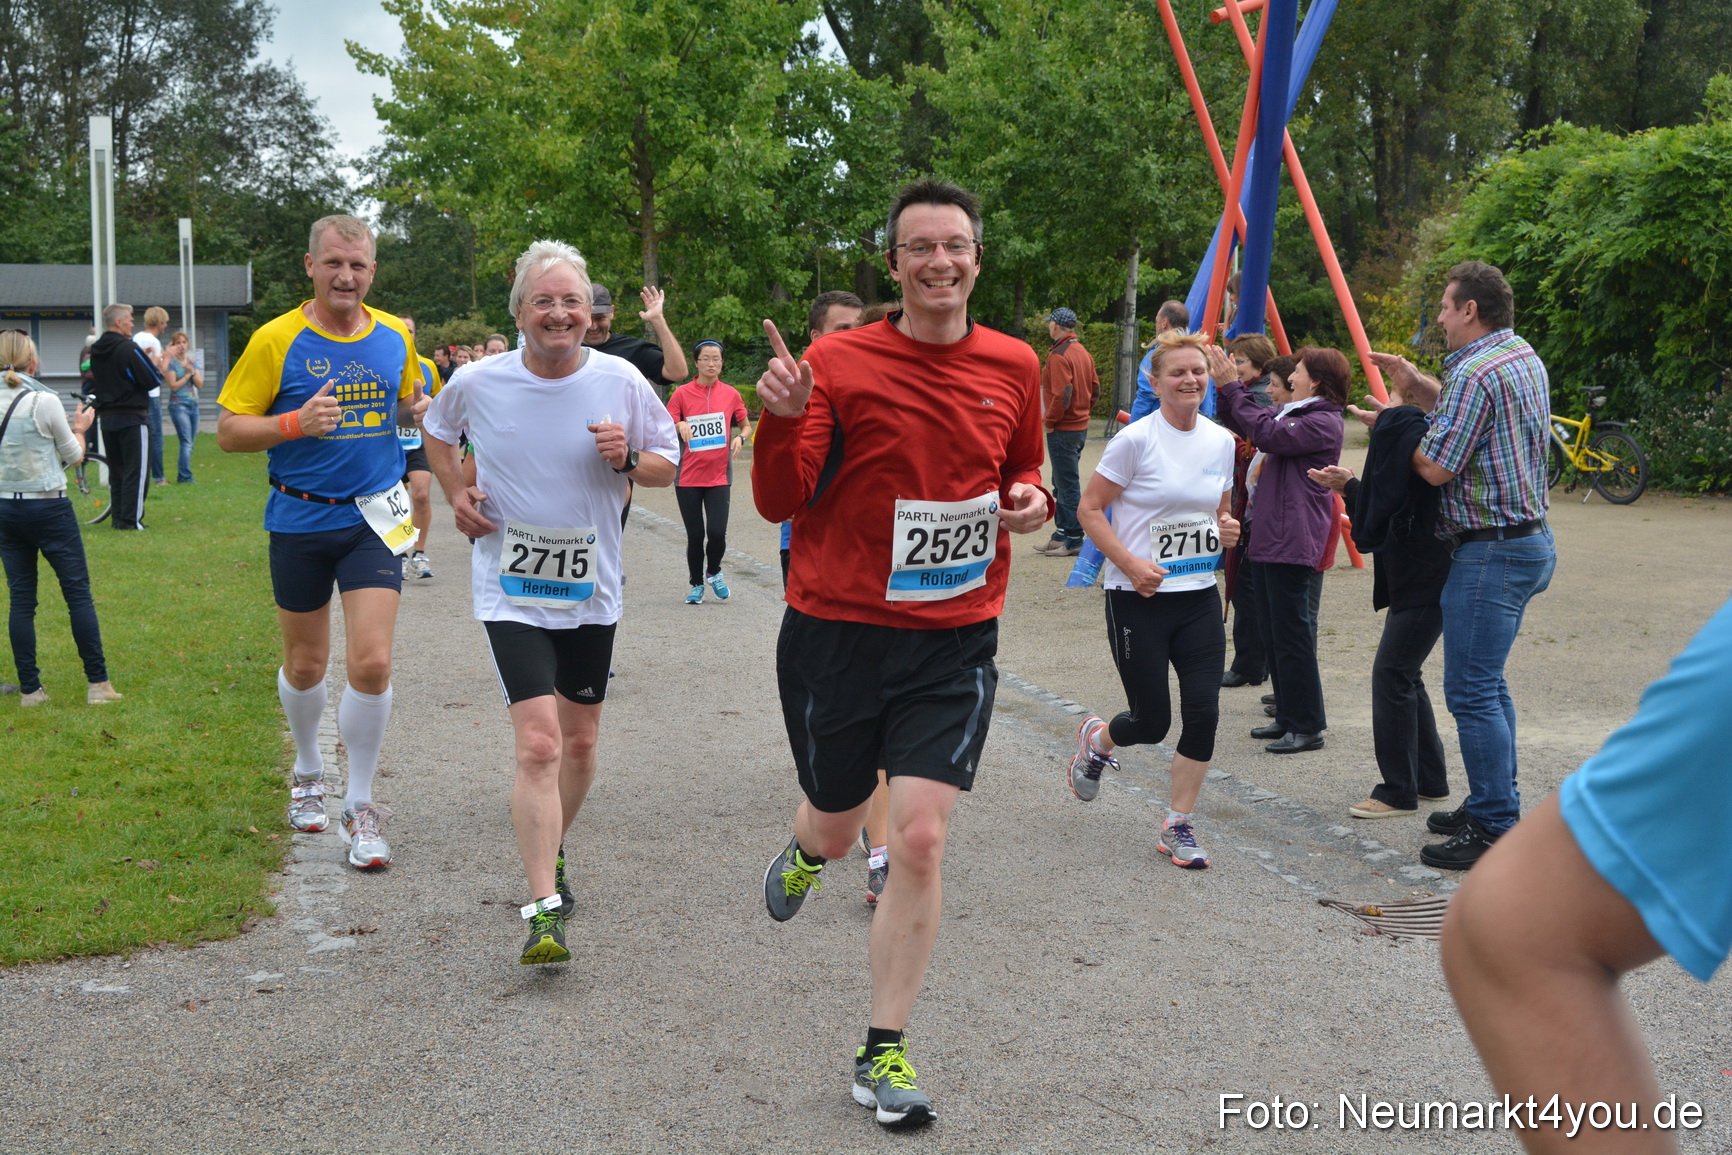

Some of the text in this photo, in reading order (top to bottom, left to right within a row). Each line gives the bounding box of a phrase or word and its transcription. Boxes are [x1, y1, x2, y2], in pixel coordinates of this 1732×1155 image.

[691, 422, 723, 437] 2088
[387, 490, 409, 517] 42
[897, 507, 986, 522] PARTL Neumarkt
[1151, 518, 1209, 532] PARTL Neumarkt
[507, 527, 583, 545] PARTL Neumarkt
[905, 520, 990, 566] 2523
[1159, 528, 1219, 559] 2716
[508, 543, 588, 579] 2715
[1168, 561, 1212, 575] Marianne
[920, 569, 969, 586] Roland
[522, 581, 570, 597] Herbert
